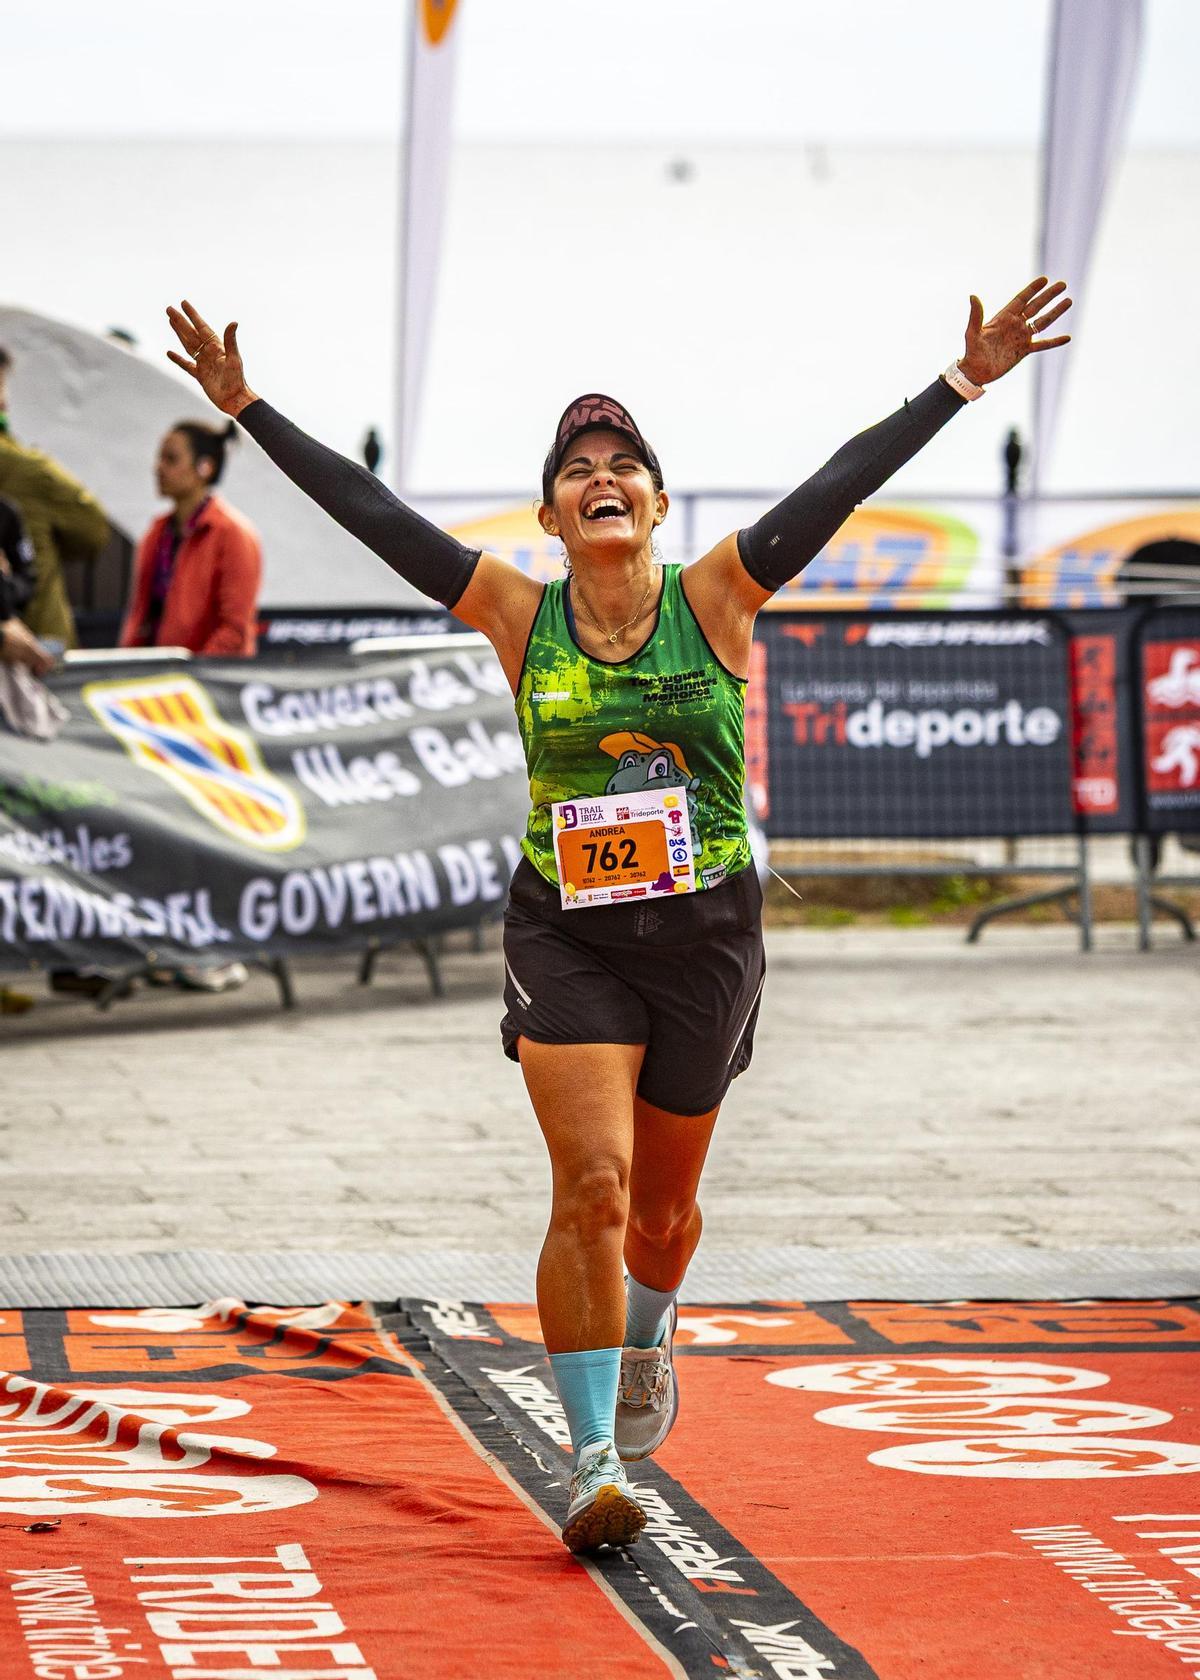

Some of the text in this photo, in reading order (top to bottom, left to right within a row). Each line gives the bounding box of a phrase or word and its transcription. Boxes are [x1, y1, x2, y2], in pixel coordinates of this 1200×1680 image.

[662, 678, 717, 692] Runners
[643, 687, 711, 702] Menorca
[781, 702, 1061, 758] Trideporte
[578, 805, 604, 815] TRAIL
[630, 808, 664, 818] Trideporte
[581, 812, 605, 823] IBIZA
[589, 826, 626, 838] ANDREA
[669, 837, 687, 847] BUS
[581, 838, 639, 874] 762
[238, 849, 441, 943] GOVERN
[438, 837, 503, 907] DE
